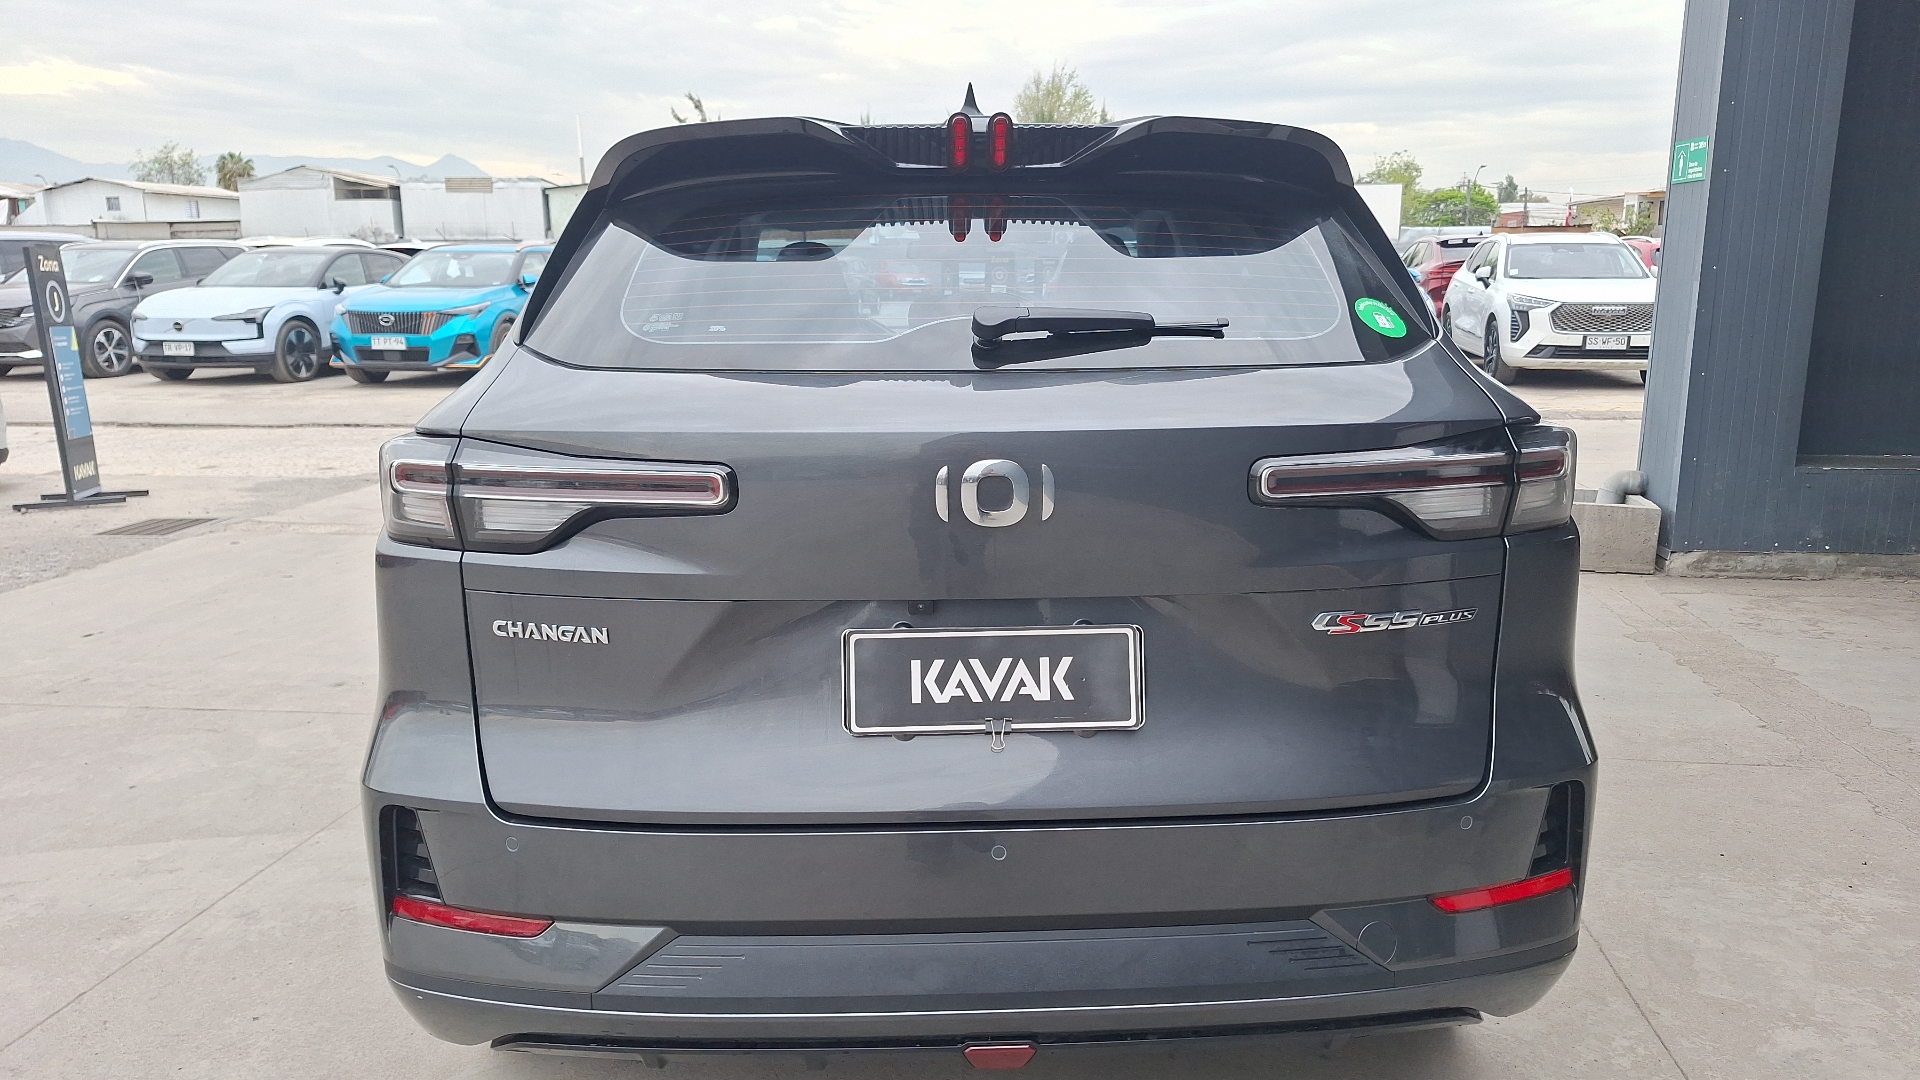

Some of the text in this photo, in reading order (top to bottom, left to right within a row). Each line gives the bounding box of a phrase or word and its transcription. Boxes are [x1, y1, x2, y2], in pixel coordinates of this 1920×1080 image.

[37, 254, 60, 273] Zona
[492, 619, 609, 645] CHANGAN
[1311, 609, 1476, 635] CS55 PLUS
[910, 656, 1075, 704] KAVAK
